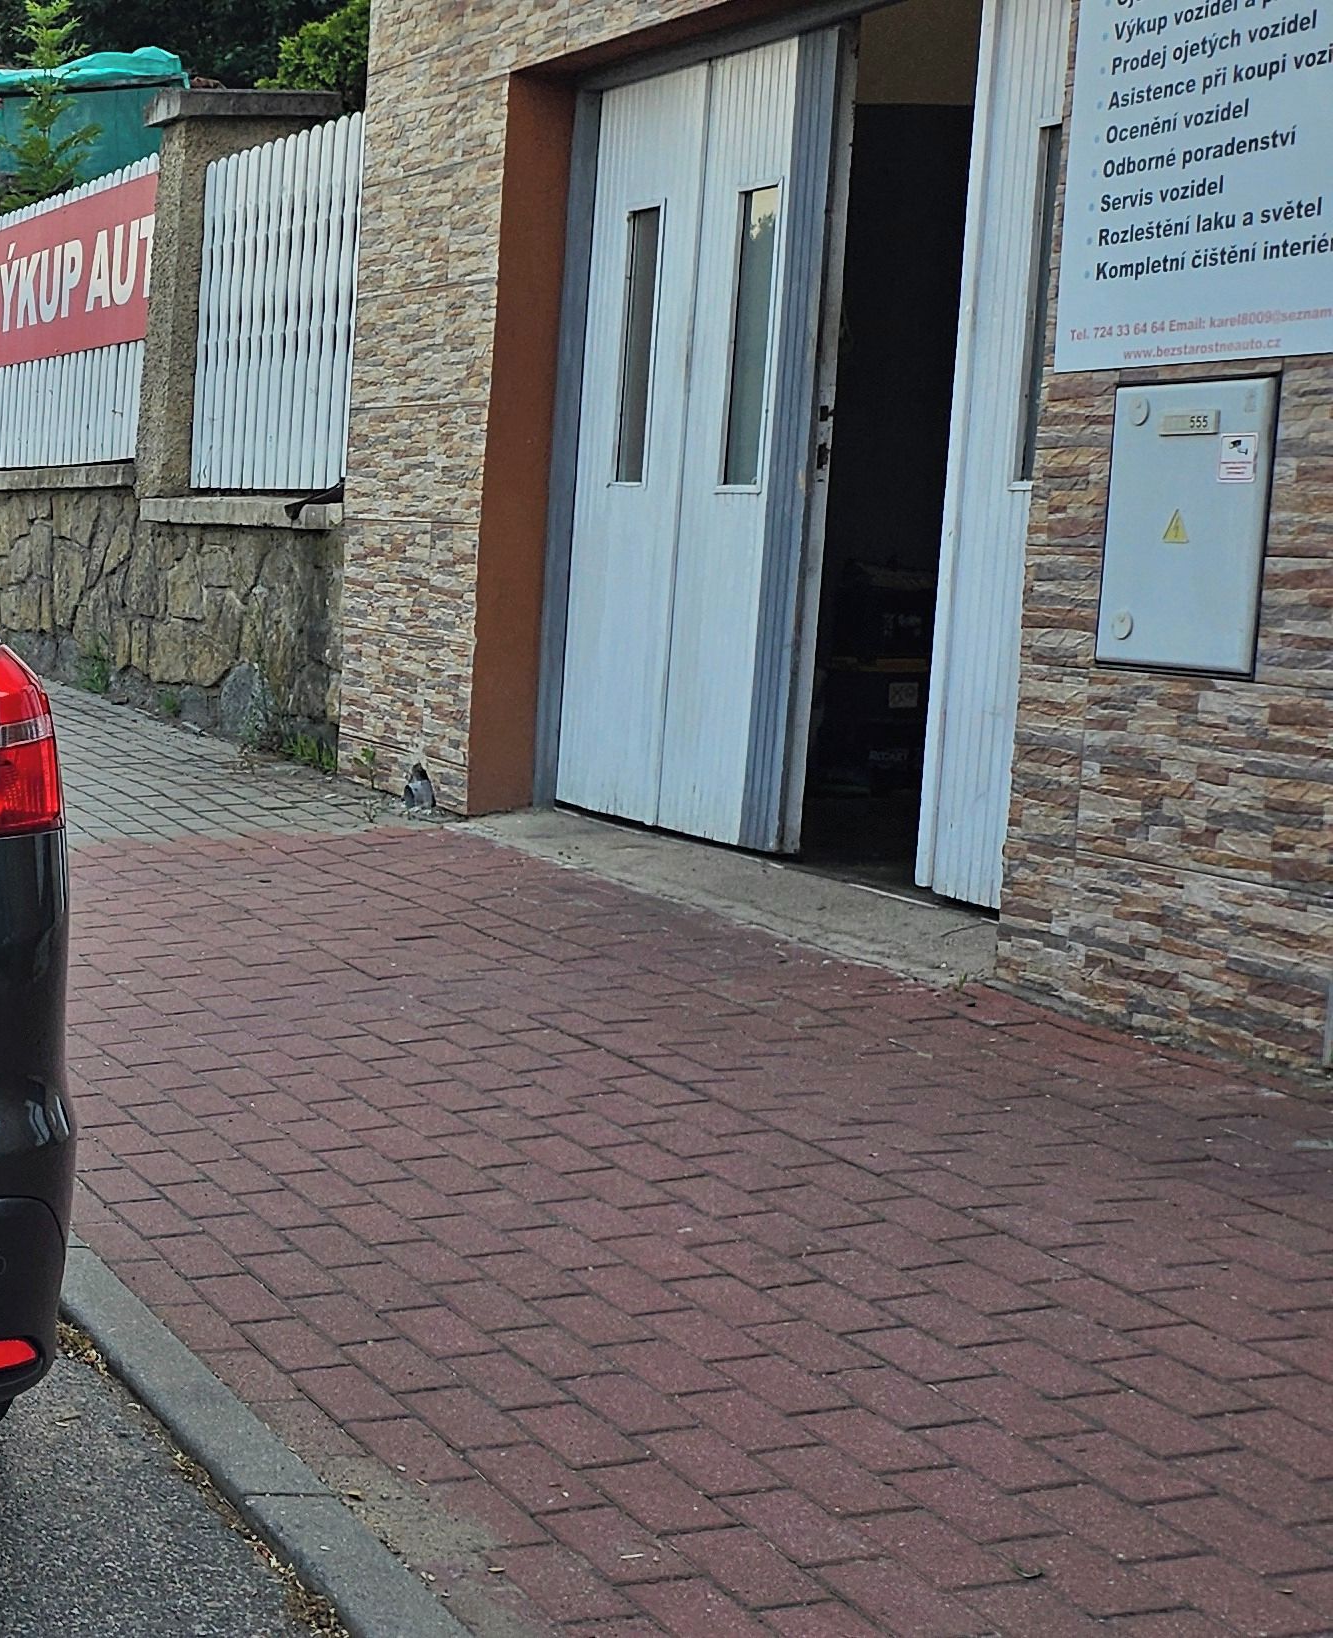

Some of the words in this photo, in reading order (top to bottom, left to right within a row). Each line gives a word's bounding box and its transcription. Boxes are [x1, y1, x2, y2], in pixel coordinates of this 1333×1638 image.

[1111, 45, 1167, 75] Prodej
[1172, 28, 1241, 64] ojetých
[1248, 8, 1318, 43] vozidel
[1114, 15, 1168, 43] Výkup
[1107, 78, 1196, 110] Asistence
[1201, 66, 1228, 94] při
[1233, 53, 1287, 83] koupi
[1106, 112, 1178, 144] Ocenění
[1183, 98, 1250, 129] vozidel
[1103, 148, 1176, 178] Odborné
[1182, 125, 1298, 169] poradenství
[1100, 188, 1153, 213] Servis
[1159, 174, 1224, 203] vozidel
[1098, 215, 1191, 247] Rozleštění
[1196, 211, 1236, 233] laku
[1242, 211, 1254, 227] a
[1260, 196, 1323, 225] světel
[85, 214, 156, 313] AUT
[1095, 252, 1186, 281] Kompletní
[1191, 241, 1258, 269] čištění
[1070, 328, 1089, 342] Tel.
[1093, 325, 1113, 339] 724
[1116, 324, 1130, 337] 33
[1134, 322, 1148, 336] 64
[1151, 320, 1165, 334] 64
[1169, 318, 1206, 332] Email:
[1190, 416, 1209, 429] 555
